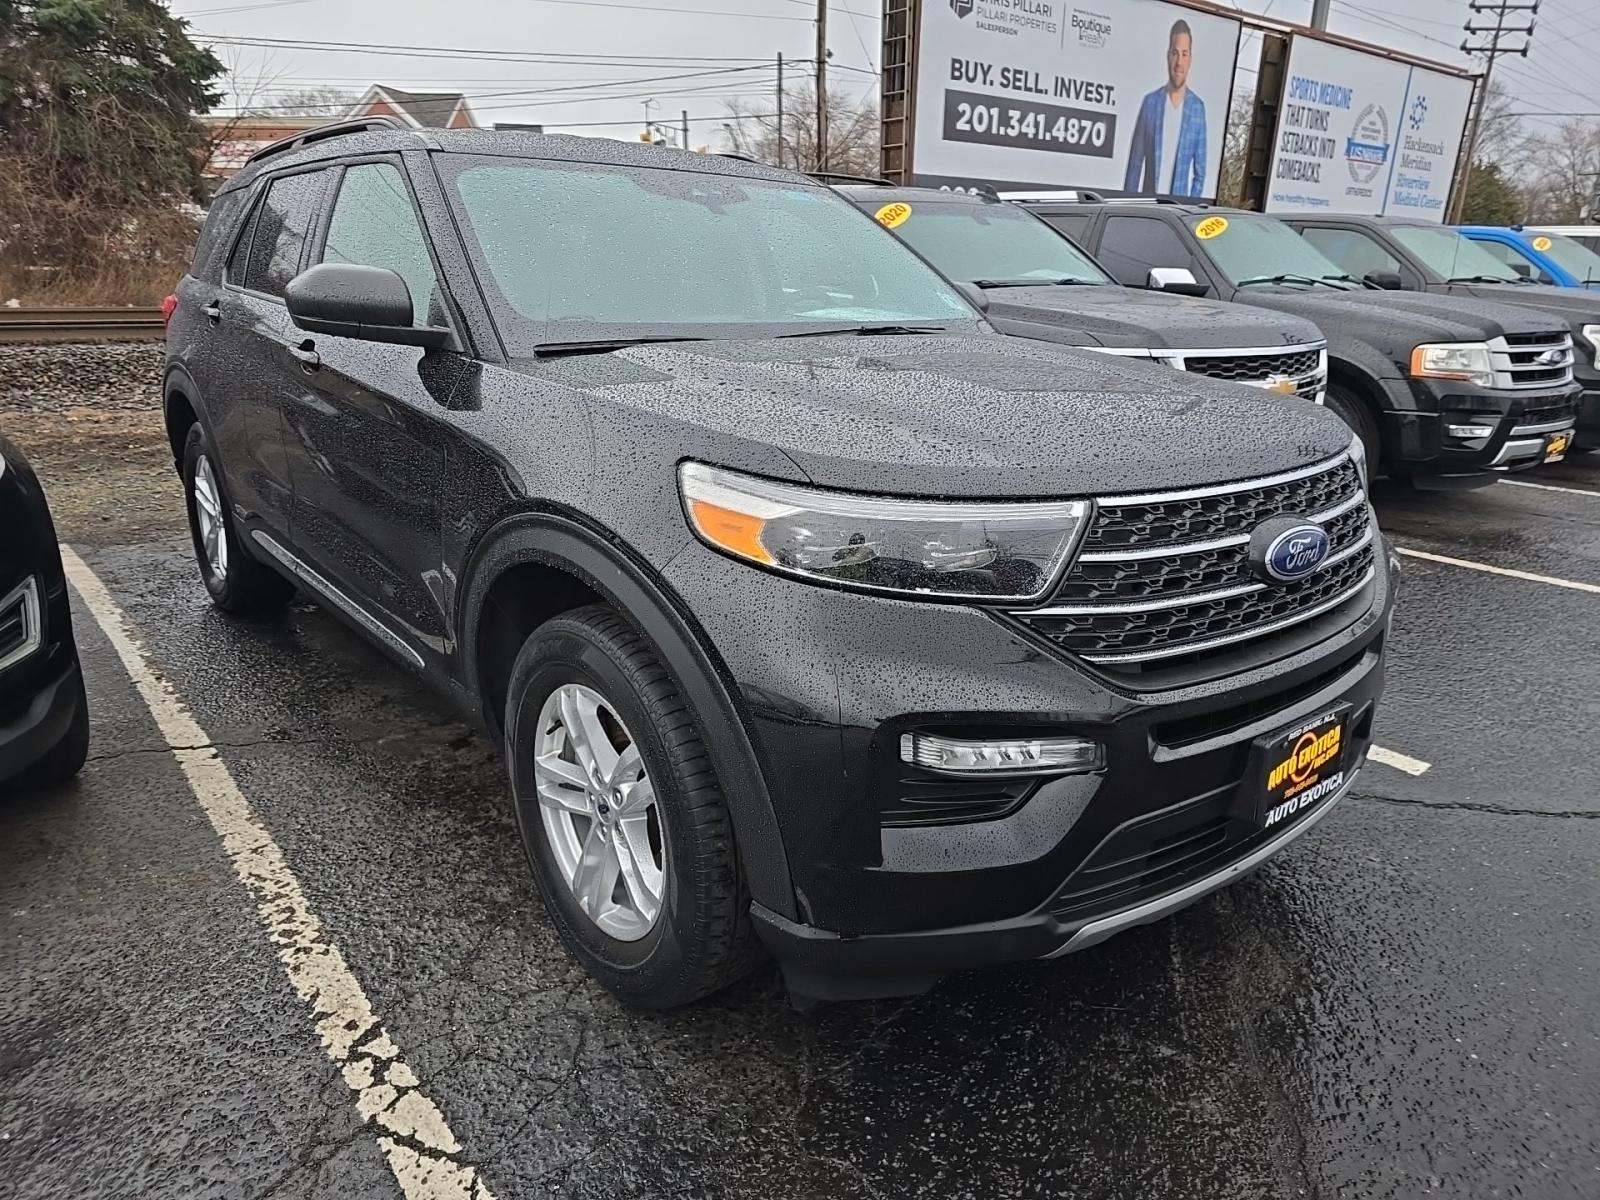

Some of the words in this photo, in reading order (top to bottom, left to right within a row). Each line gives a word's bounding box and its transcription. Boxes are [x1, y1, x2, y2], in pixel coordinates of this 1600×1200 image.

[1014, 0, 1052, 17] PILLARI
[1009, 13, 1057, 34] PROPERTIES
[1072, 14, 1112, 37] Boutique
[951, 57, 994, 86] BUY.
[1000, 66, 1048, 95] SELL.
[1054, 75, 1116, 106] INVEST.
[1289, 76, 1319, 103] SPORTS
[1318, 82, 1354, 110] MEDICINE
[955, 102, 1107, 147] 201.341.4870
[1285, 104, 1306, 127] THAT
[1304, 108, 1330, 132] TURNS
[1280, 131, 1319, 157] SETBACKS
[1318, 138, 1336, 159] INTO
[880, 204, 907, 226] 2020
[1200, 218, 1225, 236] 2016
[1286, 537, 1321, 570] Ford
[1267, 755, 1298, 792] AUTO
[1298, 724, 1341, 769] EXOTICA
[1265, 798, 1298, 828] AUTO
[1299, 771, 1344, 809] EXOTICA
